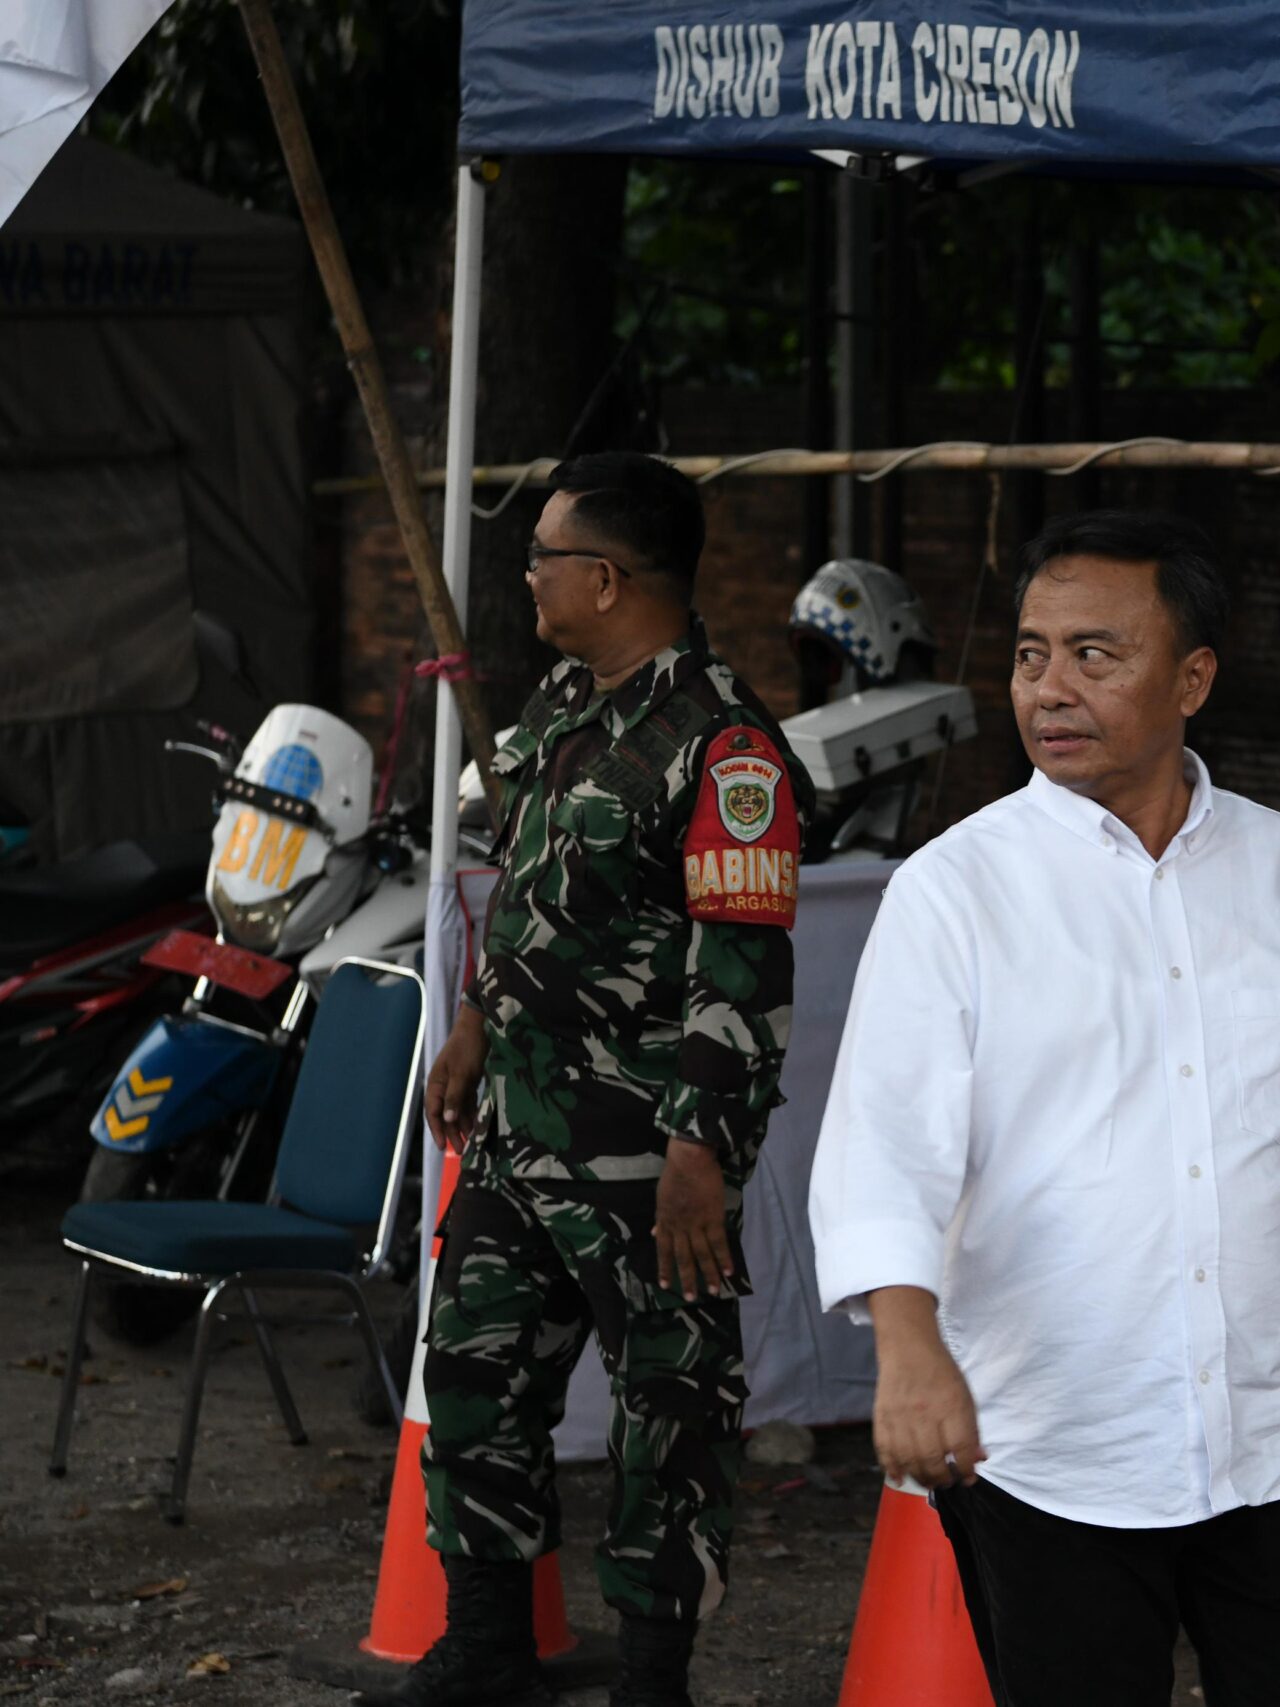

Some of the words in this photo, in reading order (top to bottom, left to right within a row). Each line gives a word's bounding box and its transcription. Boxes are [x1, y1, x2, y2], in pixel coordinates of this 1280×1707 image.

[653, 24, 784, 118] DISHUB
[804, 21, 902, 120] KOTA
[912, 22, 1079, 128] CIREBON
[63, 241, 197, 304] BARAT
